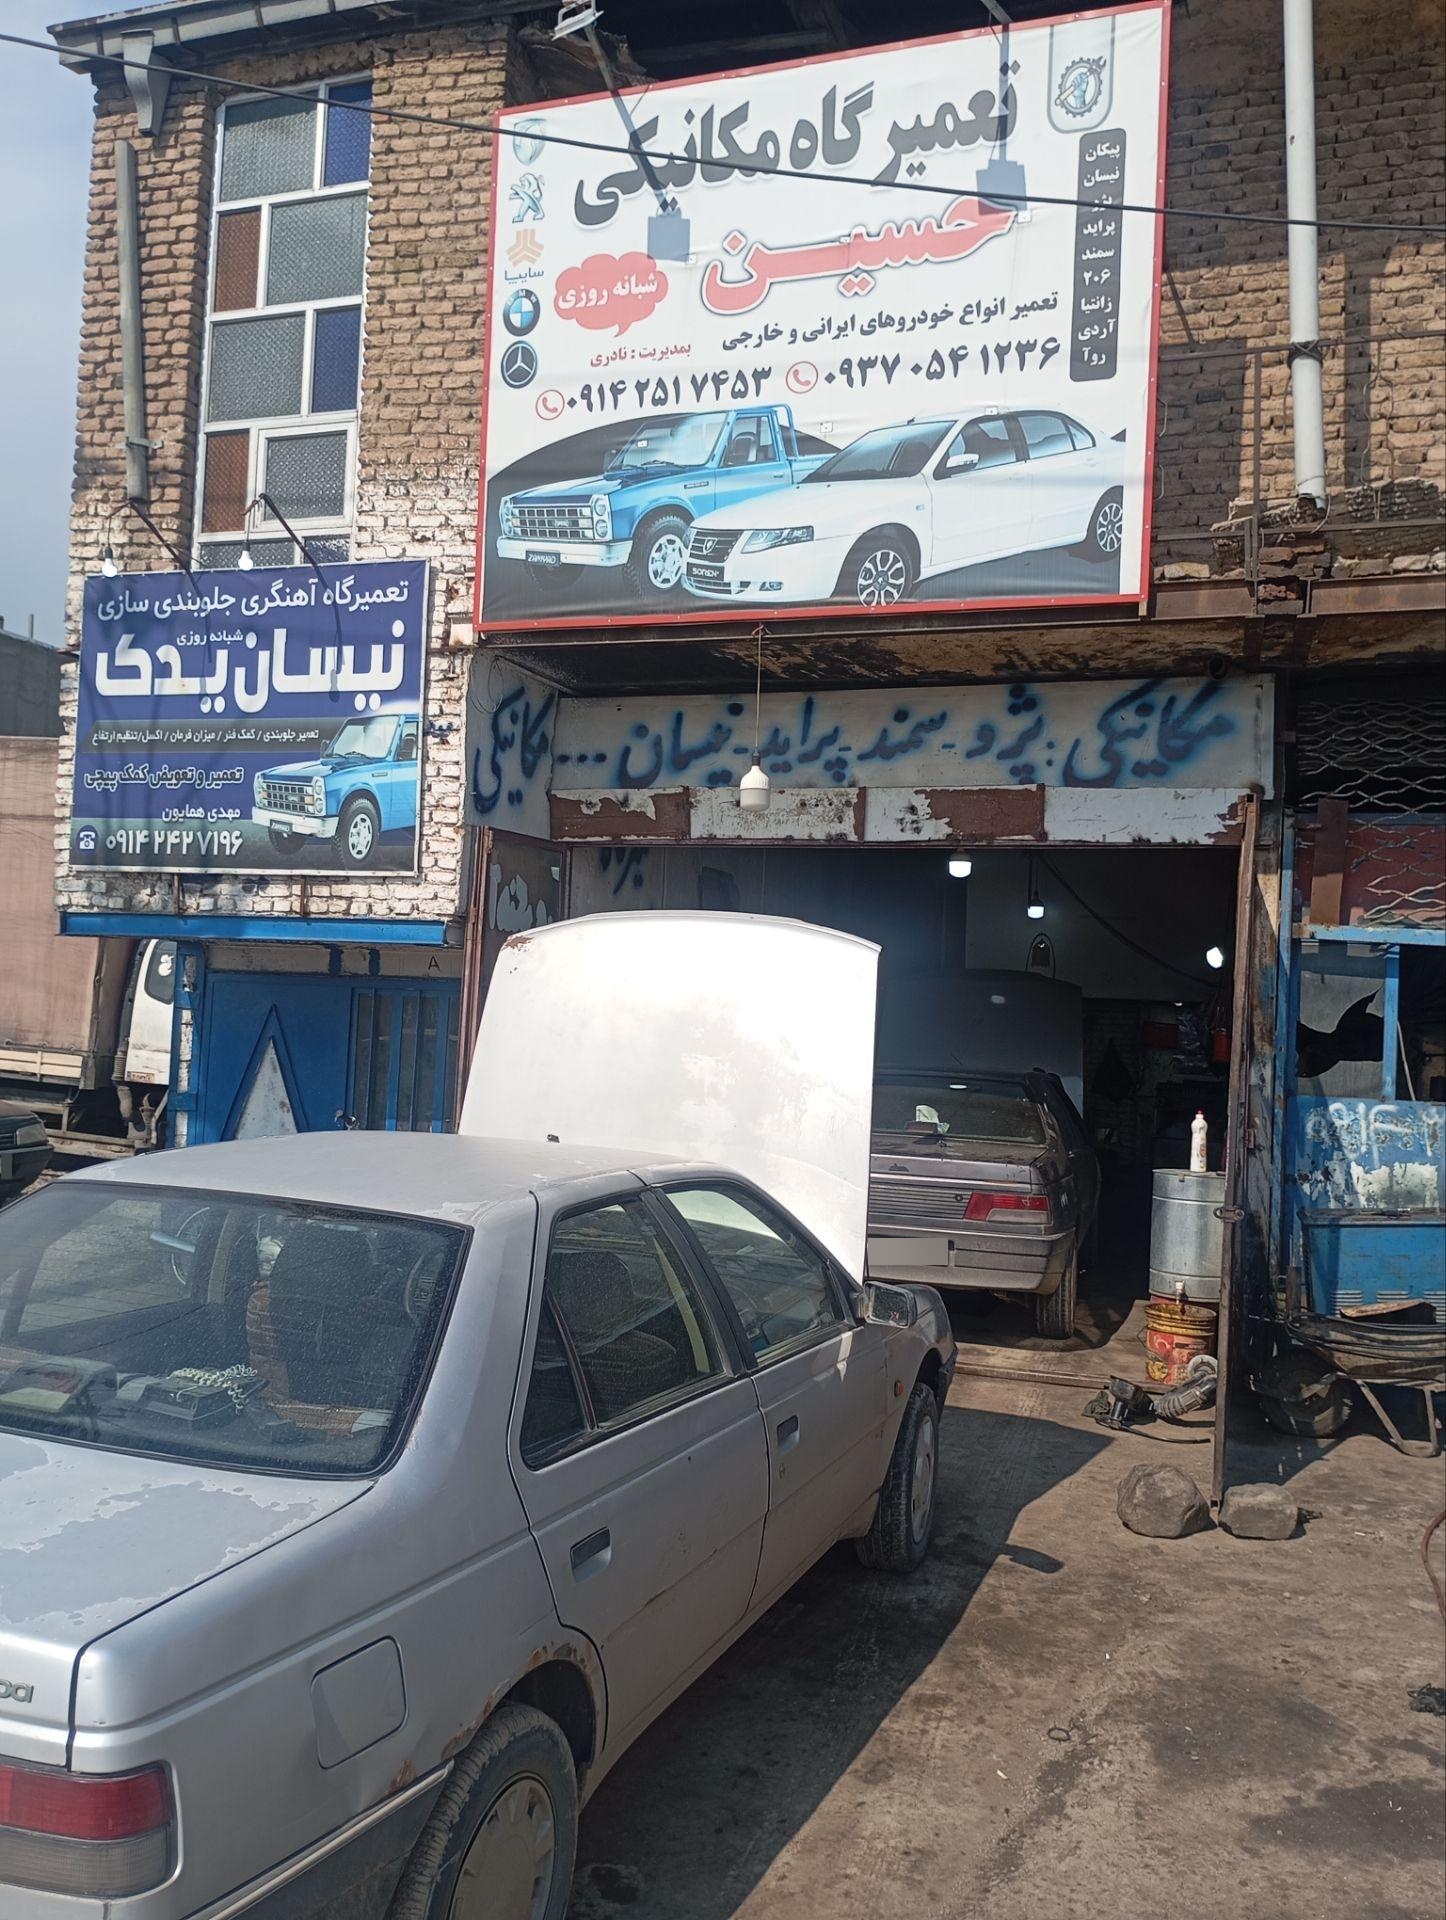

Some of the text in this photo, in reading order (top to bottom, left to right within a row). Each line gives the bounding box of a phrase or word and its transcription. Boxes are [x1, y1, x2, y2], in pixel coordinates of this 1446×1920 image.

[1085, 141, 1121, 162] پیکان
[574, 101, 780, 226] مکانیکی
[1083, 167, 1120, 188] نیسان
[1083, 219, 1116, 237] پراید
[701, 194, 1018, 317] حسین
[1081, 246, 1115, 260] سمند
[504, 267, 544, 285] سایپا
[1083, 268, 1111, 287] ۲۰۶
[558, 273, 658, 310] شبانه روزی
[1080, 296, 1112, 314] زانتیا
[722, 291, 1059, 351] تعمیر انواع خودروهای ایرانی و خارجی
[1078, 318, 1116, 341] آردی
[591, 347, 627, 368] نادری
[824, 336, 1061, 388] ۰۹۳۷ ۰۵۴ ۱۲۳۶
[1082, 348, 1106, 365] روآ
[567, 366, 772, 412] ۰۹۱۴ ۲۵۱ ۷۴۵۳
[98, 575, 409, 621] تعمیرگاه آهنگری جلوبندی سازی
[177, 629, 243, 646] شبانه روزی
[95, 620, 405, 714] نیسان یدک
[92, 730, 116, 746] ارتفاع
[170, 730, 192, 743] فرمان
[193, 729, 216, 742] میزان
[223, 731, 236, 742] فنر
[237, 728, 256, 740] کمک
[263, 728, 296, 742] جلوبندی
[297, 728, 319, 743] تعمیر
[857, 709, 947, 760] سمند
[1062, 677, 1235, 788] مکانیکی
[619, 702, 744, 788] نیسان
[119, 763, 149, 784] کمک
[150, 765, 196, 790] تعویض
[195, 770, 205, 789] و
[205, 766, 244, 789] تعمیر
[162, 804, 241, 822] مهدی همایون
[106, 829, 243, 856] ۰۹۱۴ ۲۴۲ ۷۱۹۶
